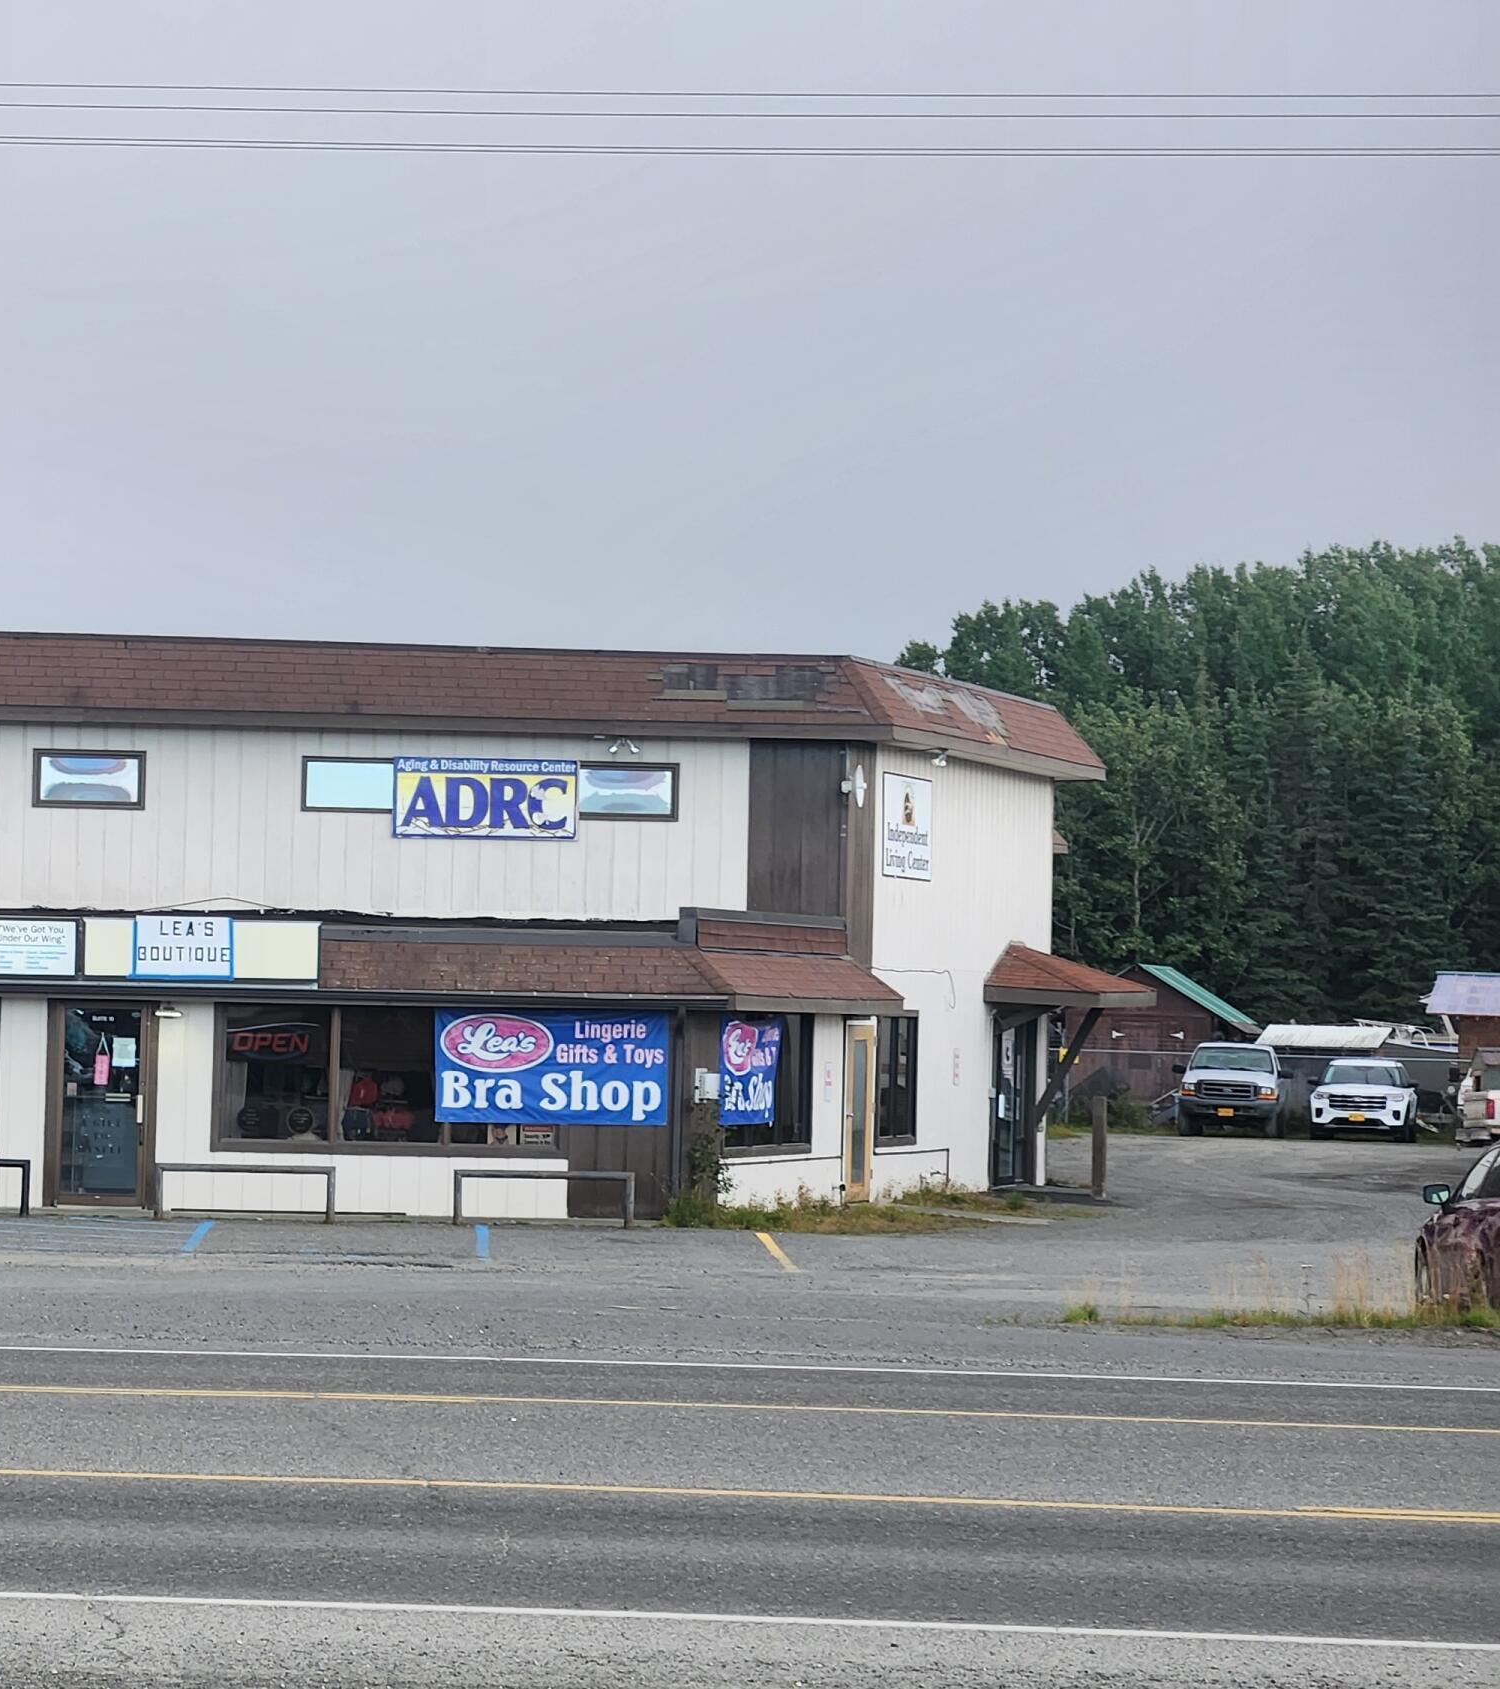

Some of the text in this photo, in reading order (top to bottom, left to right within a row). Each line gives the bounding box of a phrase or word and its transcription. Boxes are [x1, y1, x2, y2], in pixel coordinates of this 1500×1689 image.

[397, 759, 576, 773] Aging & Disability Resource Center
[400, 776, 568, 830] ADRC
[887, 822, 928, 847] Independent
[886, 848, 929, 872] Living Center
[24, 934, 39, 942] Our
[31, 925, 45, 933] Got
[48, 926, 64, 934] You
[160, 921, 214, 937] LEA'S
[137, 946, 231, 962] BOUTIQUE
[232, 1032, 310, 1053] OPEN
[457, 1022, 537, 1061] Lea's
[574, 1020, 647, 1043] Lingerie
[555, 1044, 664, 1068] Gifts & Toys
[440, 1070, 661, 1121] Bra Shop
